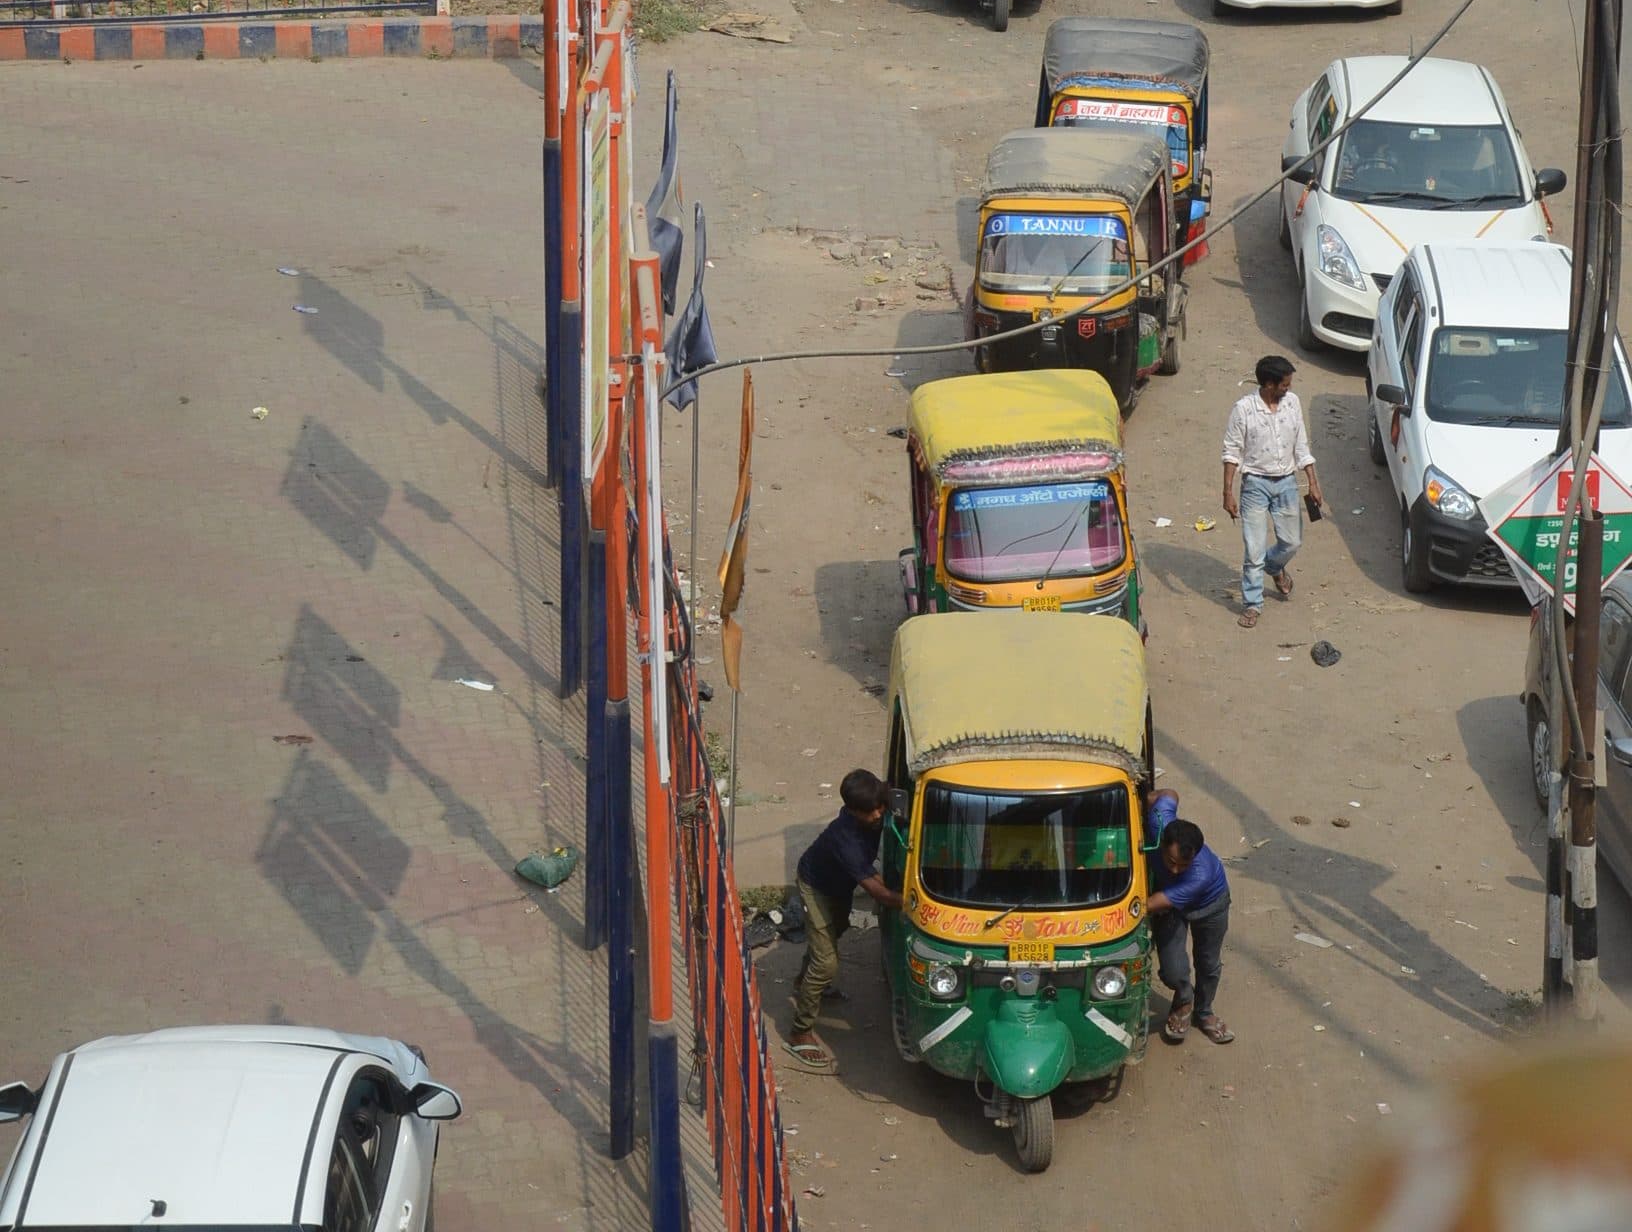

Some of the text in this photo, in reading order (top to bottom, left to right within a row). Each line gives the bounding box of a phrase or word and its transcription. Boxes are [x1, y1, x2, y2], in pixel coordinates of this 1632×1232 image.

[1080, 104, 1101, 115] जय
[1021, 218, 1086, 232] TANNU
[1104, 220, 1118, 235] R
[942, 912, 981, 936] Mini
[1017, 943, 1049, 952] BR01P
[1017, 952, 1049, 961] K5628
